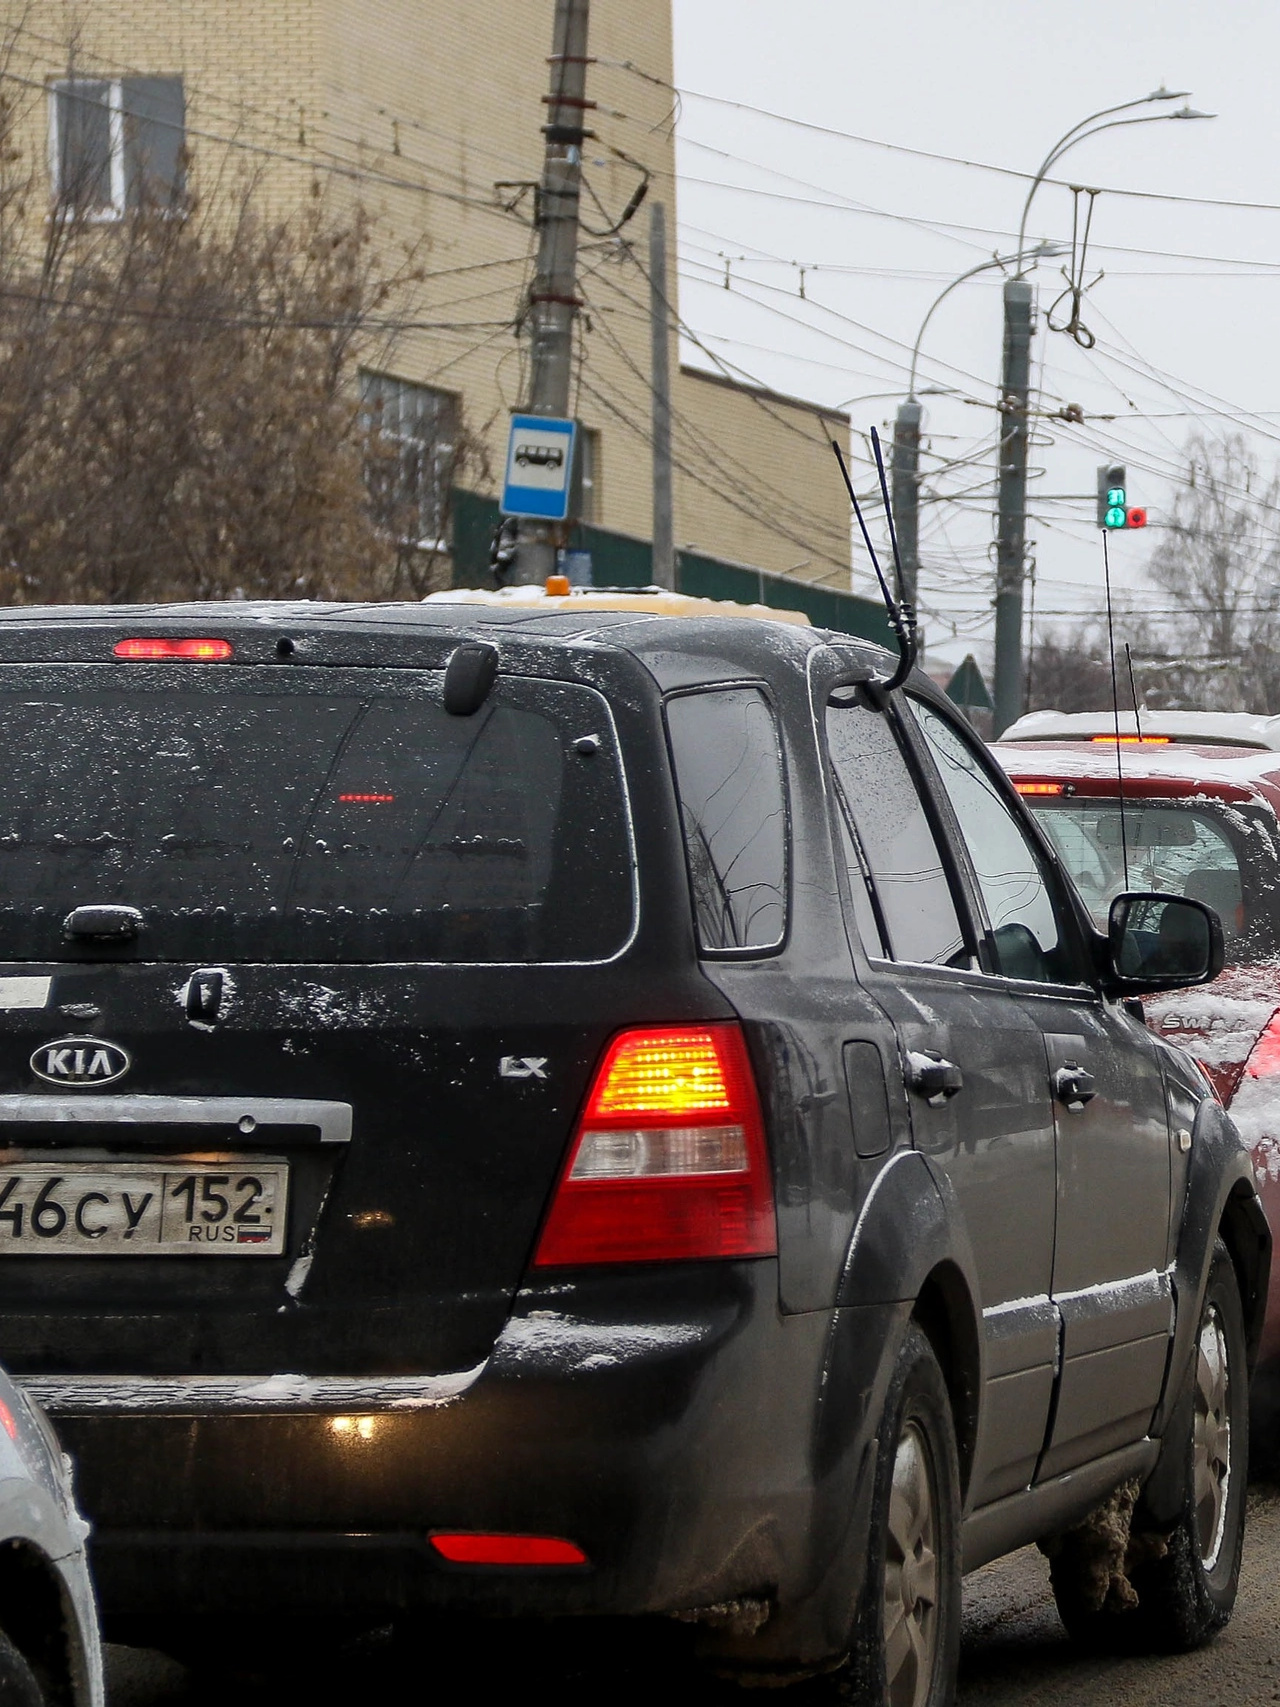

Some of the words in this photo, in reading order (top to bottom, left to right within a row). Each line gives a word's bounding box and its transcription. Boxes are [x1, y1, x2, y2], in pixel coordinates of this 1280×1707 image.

[47, 1049, 112, 1075] KIA
[171, 1176, 263, 1223] 152
[189, 1225, 235, 1242] RUS
